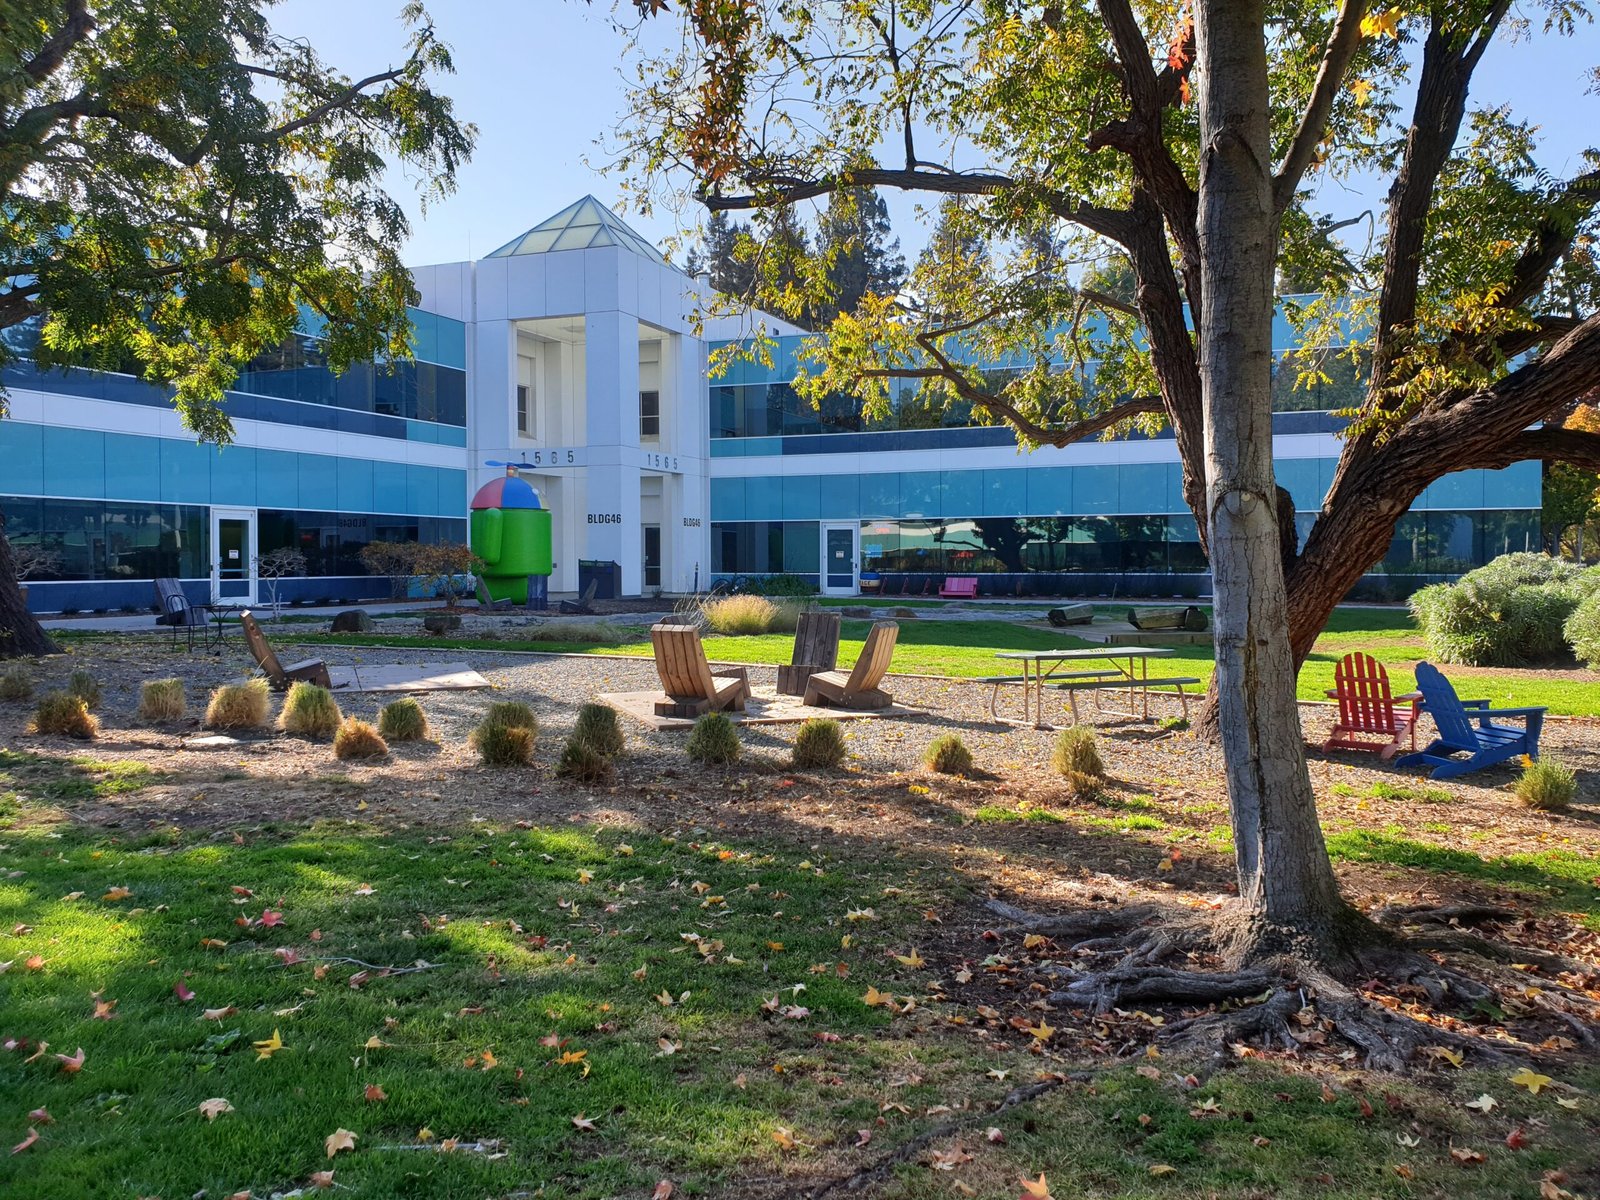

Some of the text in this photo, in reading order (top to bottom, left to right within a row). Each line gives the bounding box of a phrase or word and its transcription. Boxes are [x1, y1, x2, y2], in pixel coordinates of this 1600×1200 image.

[521, 450, 574, 464] 1565
[647, 453, 678, 470] 1565
[587, 513, 622, 524] BLDG46
